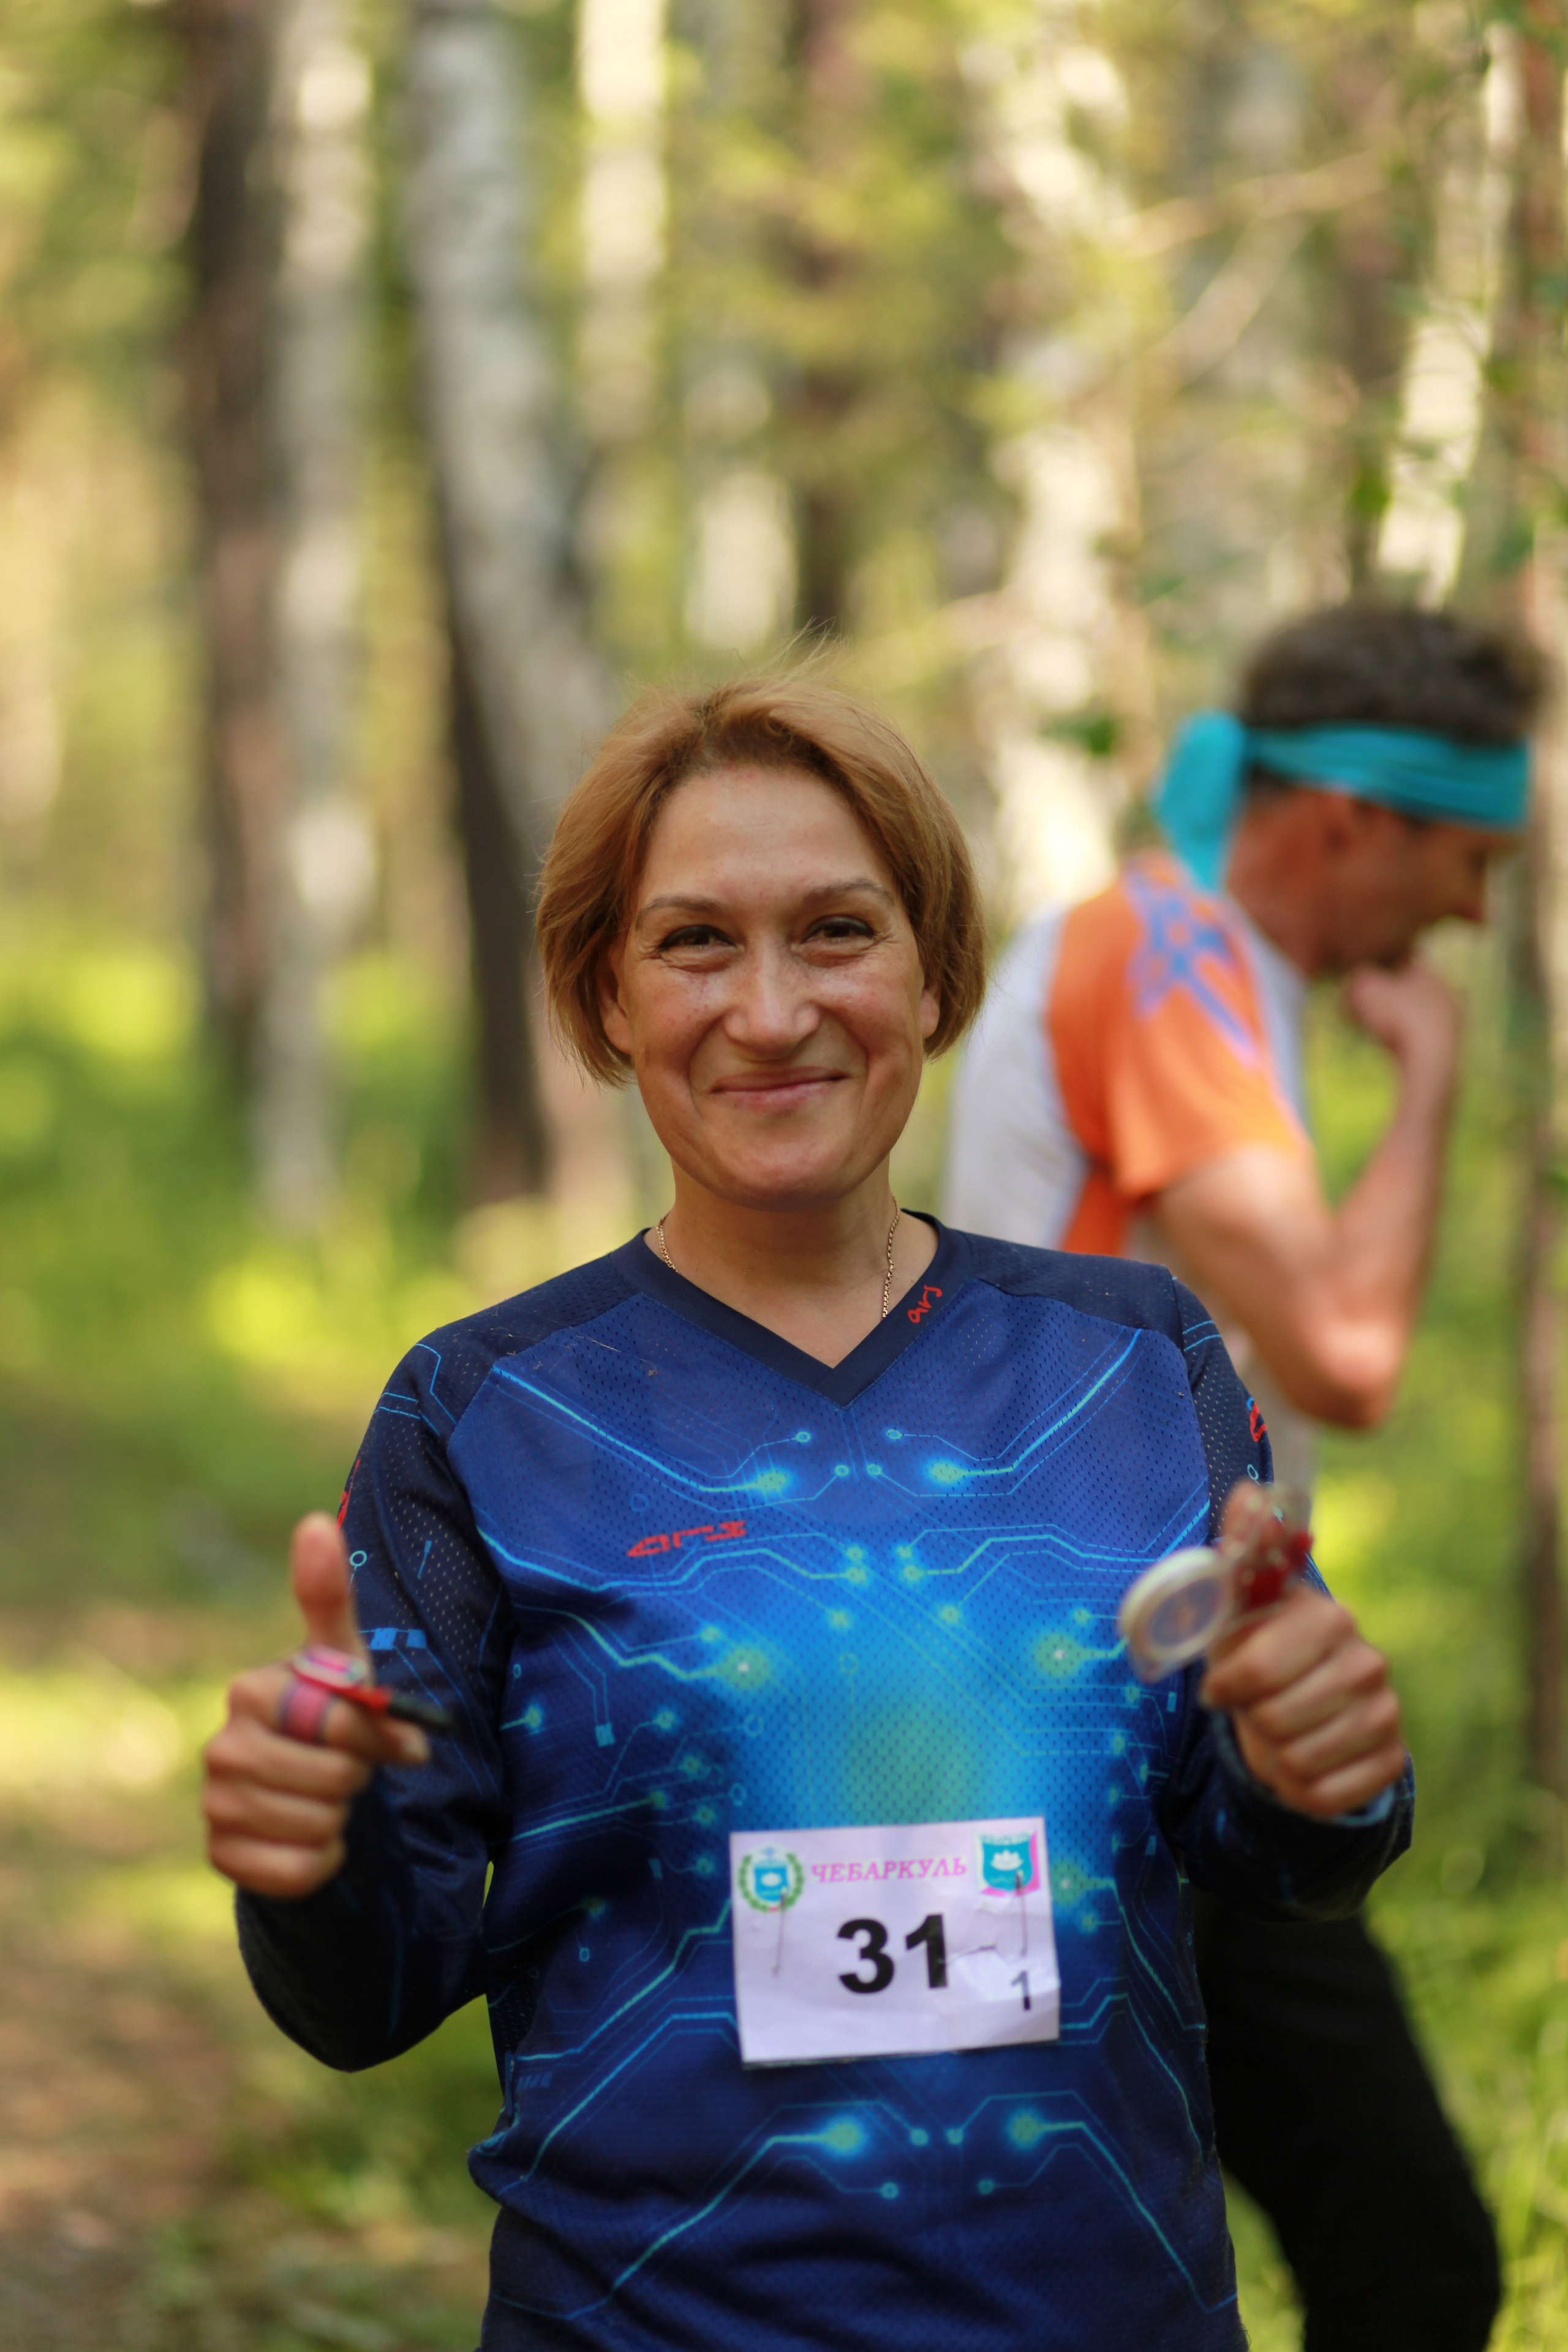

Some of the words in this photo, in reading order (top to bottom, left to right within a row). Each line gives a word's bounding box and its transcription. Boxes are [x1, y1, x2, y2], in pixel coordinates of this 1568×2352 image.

[811, 1856, 967, 1883] ЧЕБАРКУЛЬ
[836, 1913, 949, 1995] 31
[1011, 1970, 1031, 2011] 1
